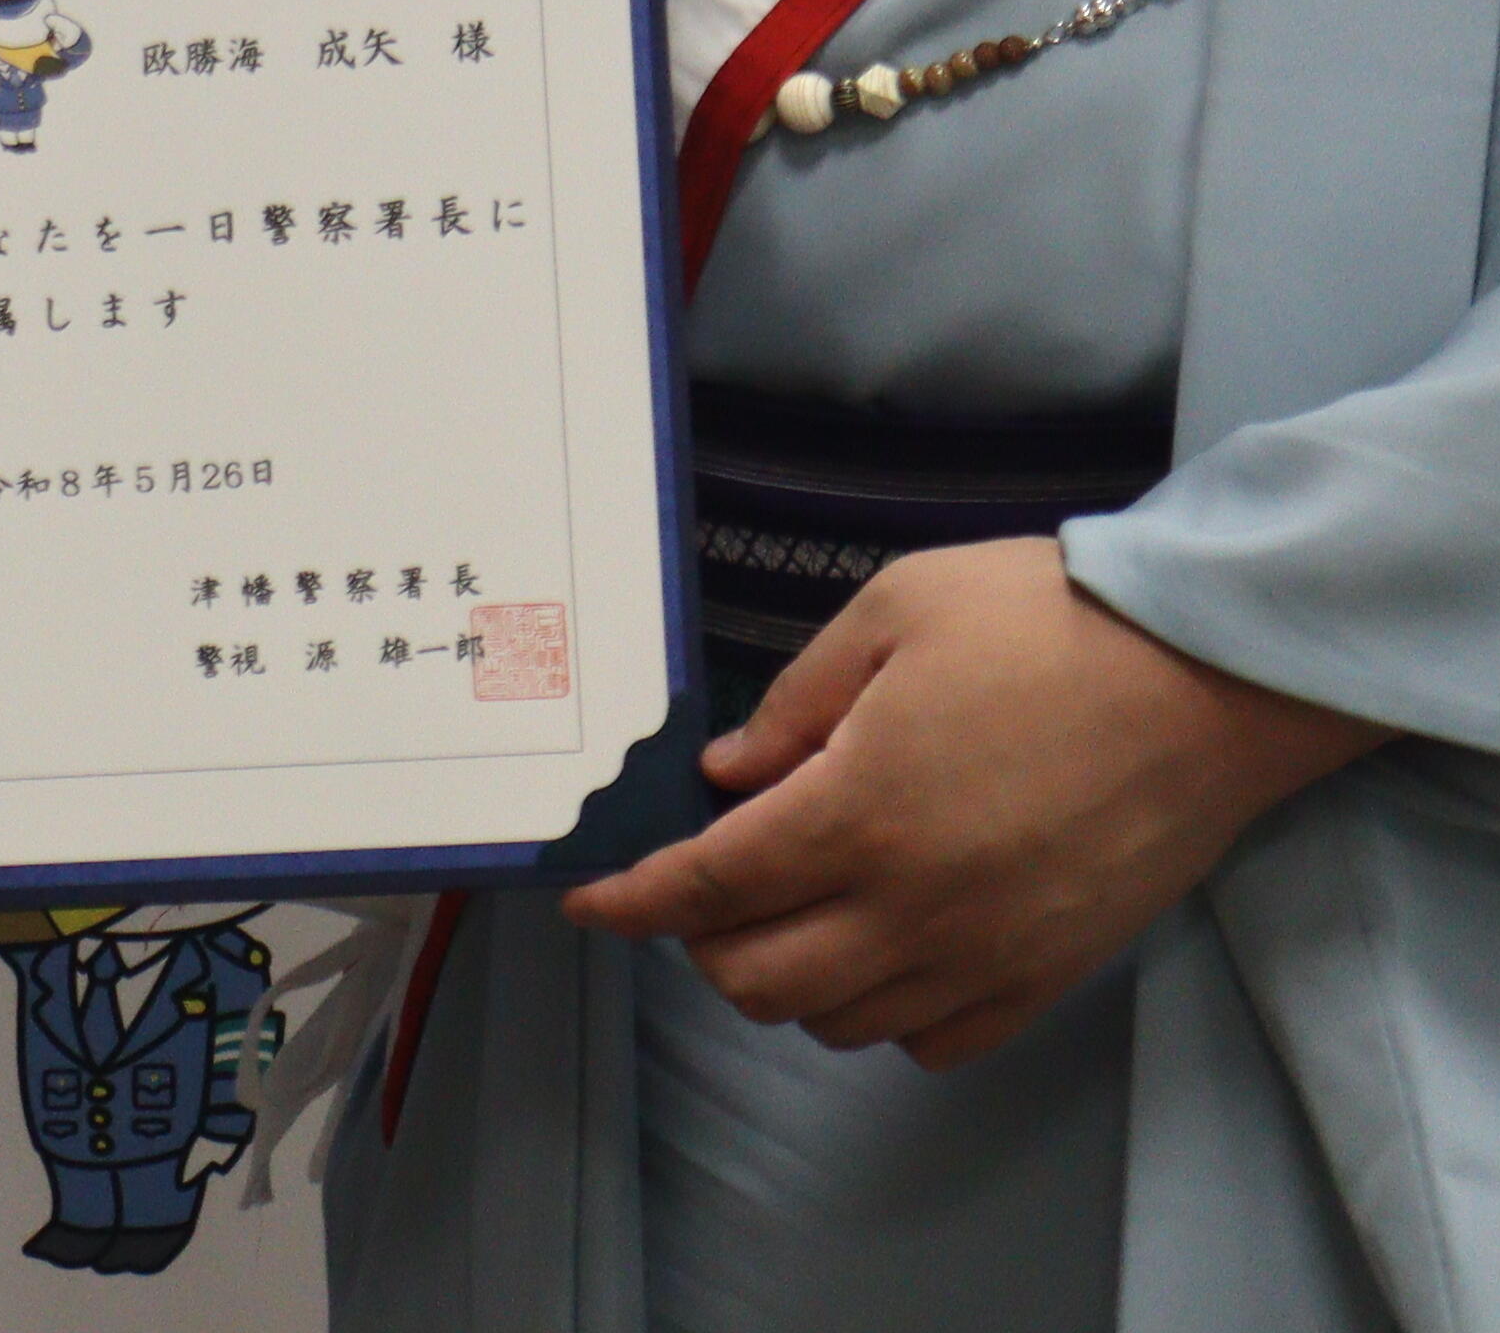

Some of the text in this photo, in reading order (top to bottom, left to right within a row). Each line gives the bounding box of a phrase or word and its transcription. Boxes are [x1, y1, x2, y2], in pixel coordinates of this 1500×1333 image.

[142, 19, 494, 76] 欧勝海 成矢 様
[191, 562, 481, 609] 津幡警察署長
[195, 632, 487, 679] 警視 源 雄一郎
